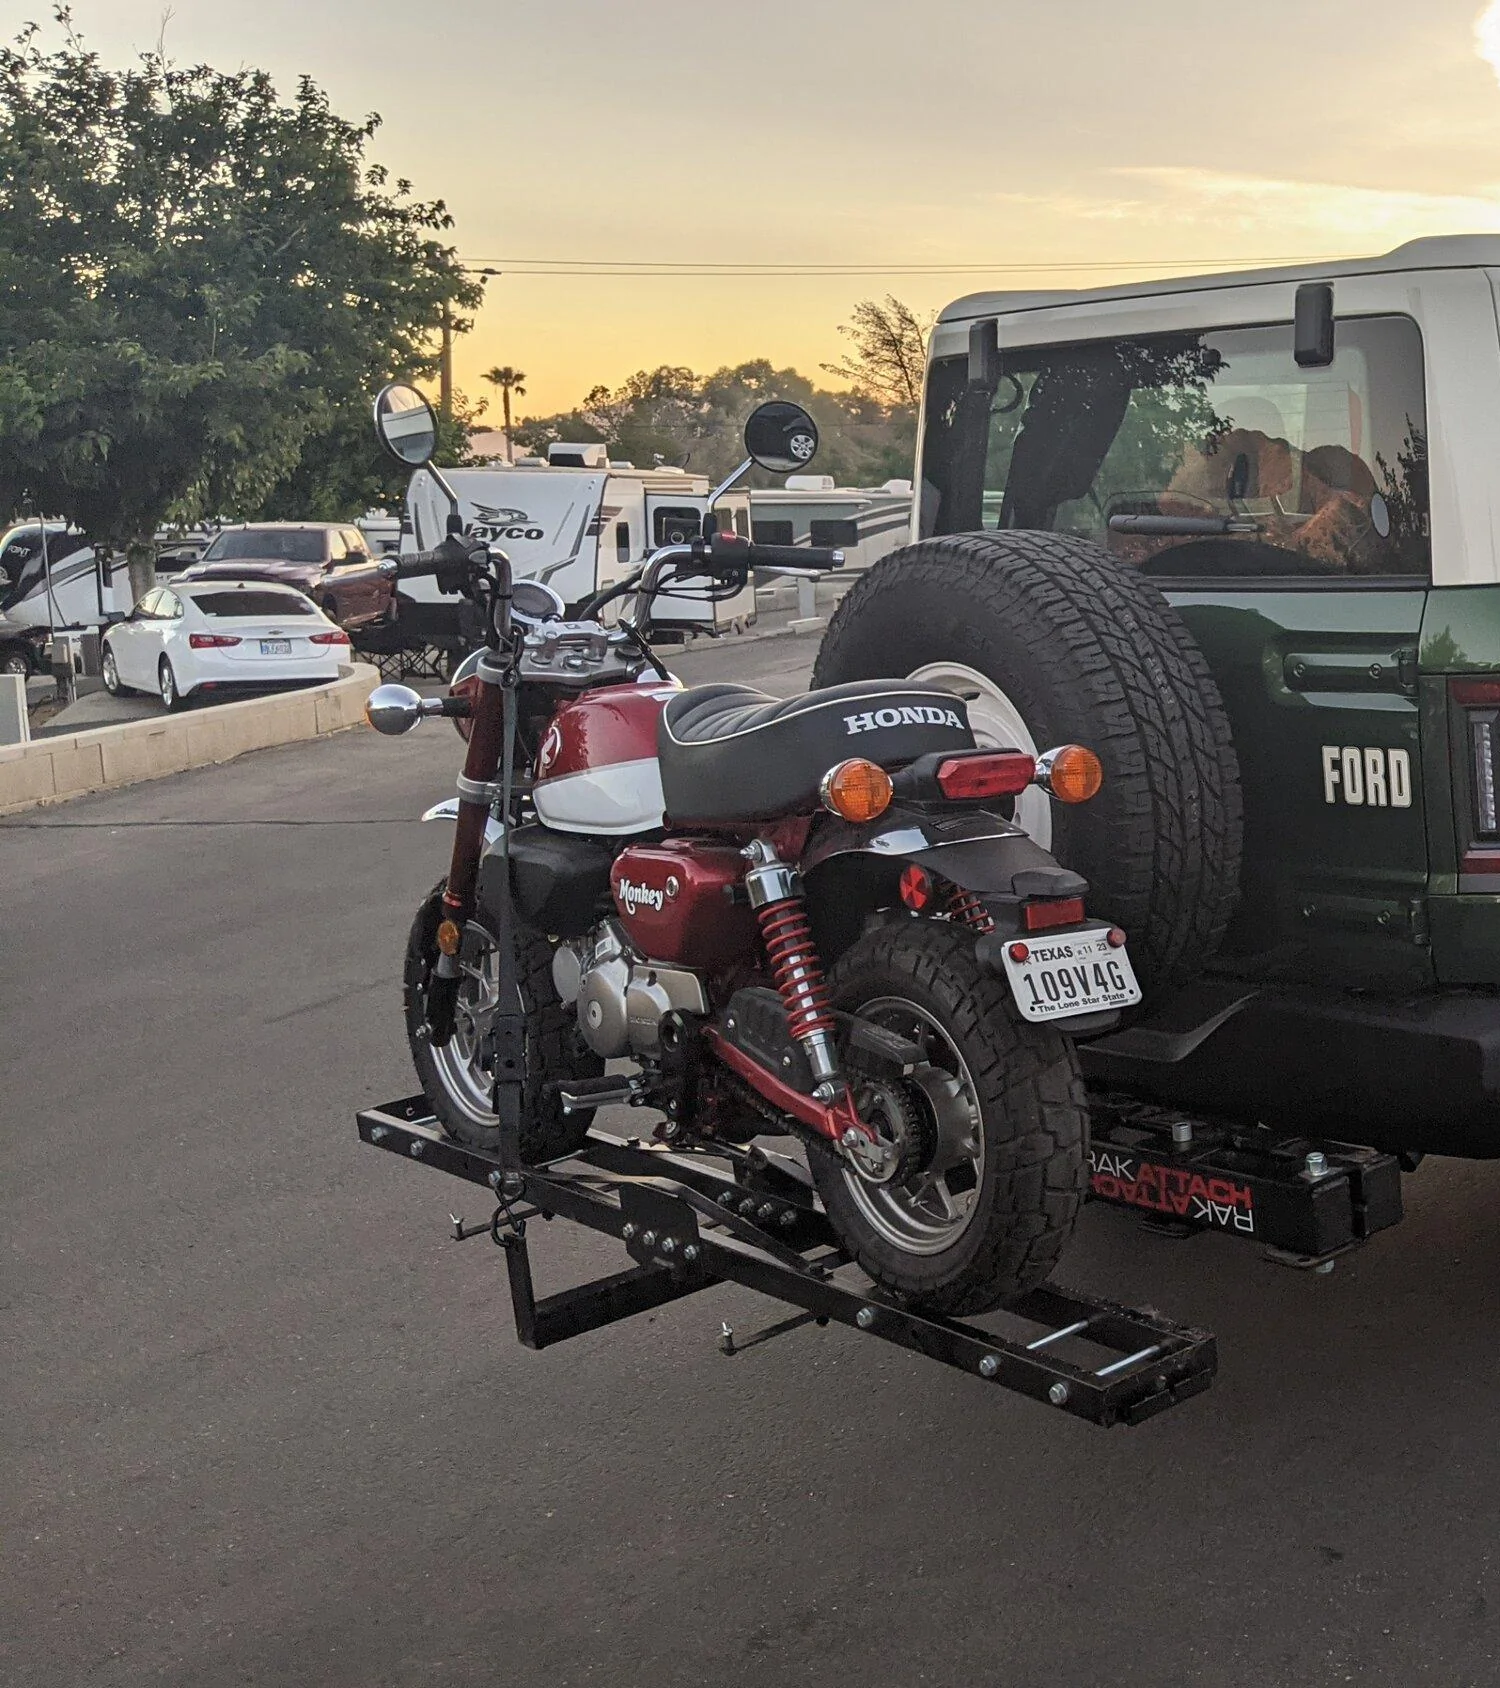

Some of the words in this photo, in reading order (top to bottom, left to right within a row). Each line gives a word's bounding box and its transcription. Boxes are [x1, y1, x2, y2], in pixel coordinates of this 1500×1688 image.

[463, 523, 545, 542] Jayco
[843, 706, 966, 735] HONDA
[1321, 745, 1413, 808] FORD
[619, 878, 664, 915] Monkey
[1031, 946, 1074, 962] TEXAS
[1096, 942, 1108, 952] 23
[1023, 961, 1127, 1005] 109V4G
[1037, 1004, 1056, 1014] The
[1058, 999, 1081, 1010] Lone
[1082, 996, 1101, 1006] Star
[1101, 992, 1126, 1003] State
[1090, 1174, 1192, 1216] ATTAC
[1136, 1162, 1254, 1210] ATTACH
[1191, 1196, 1254, 1233] RAK
